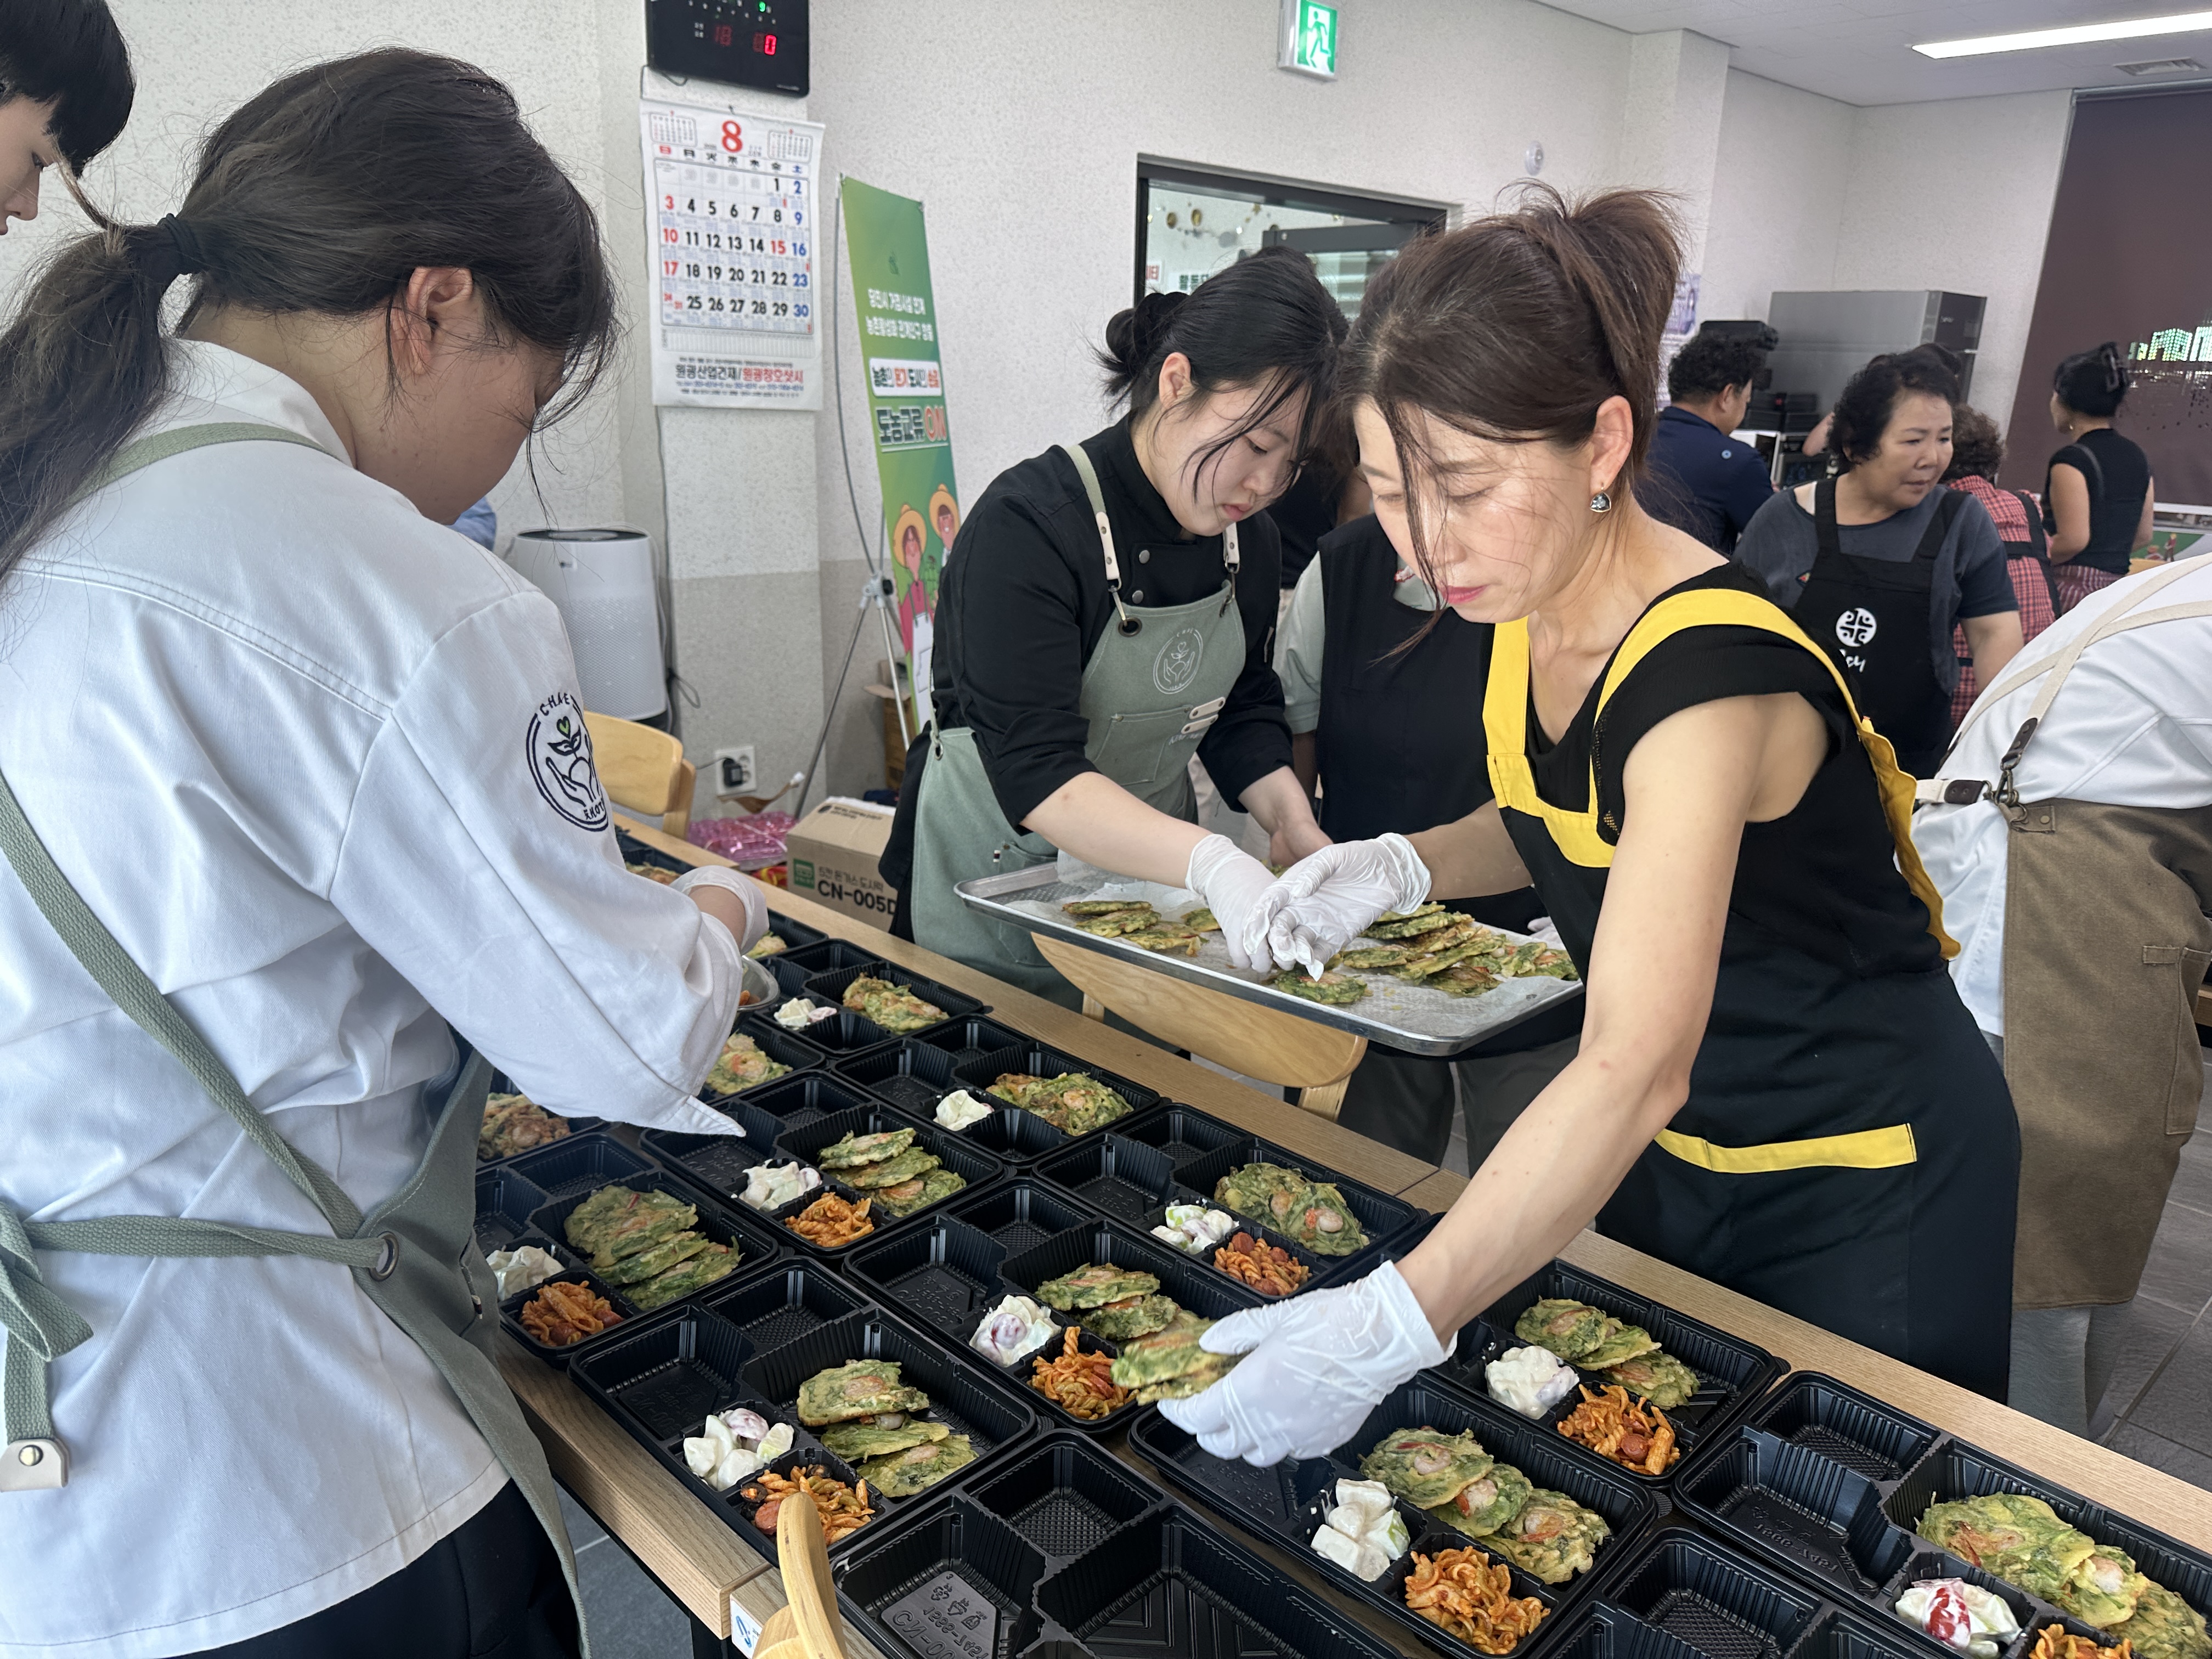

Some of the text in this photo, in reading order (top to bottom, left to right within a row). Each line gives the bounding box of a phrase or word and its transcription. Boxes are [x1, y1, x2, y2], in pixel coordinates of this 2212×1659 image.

[721, 120, 743, 153] 8
[774, 179, 802, 194] 1 2
[665, 196, 802, 225] 3 4 5 6 7 8 9
[663, 229, 806, 257] 10 11 12 13 14 15 16
[664, 261, 808, 287] 17 18 19 20 21 22 23
[687, 296, 702, 310] 25
[708, 297, 724, 312] 26
[730, 300, 744, 313] 27
[752, 301, 766, 314] 28
[772, 303, 788, 316] 29
[794, 304, 809, 317] 30
[540, 692, 570, 716] CHAE
